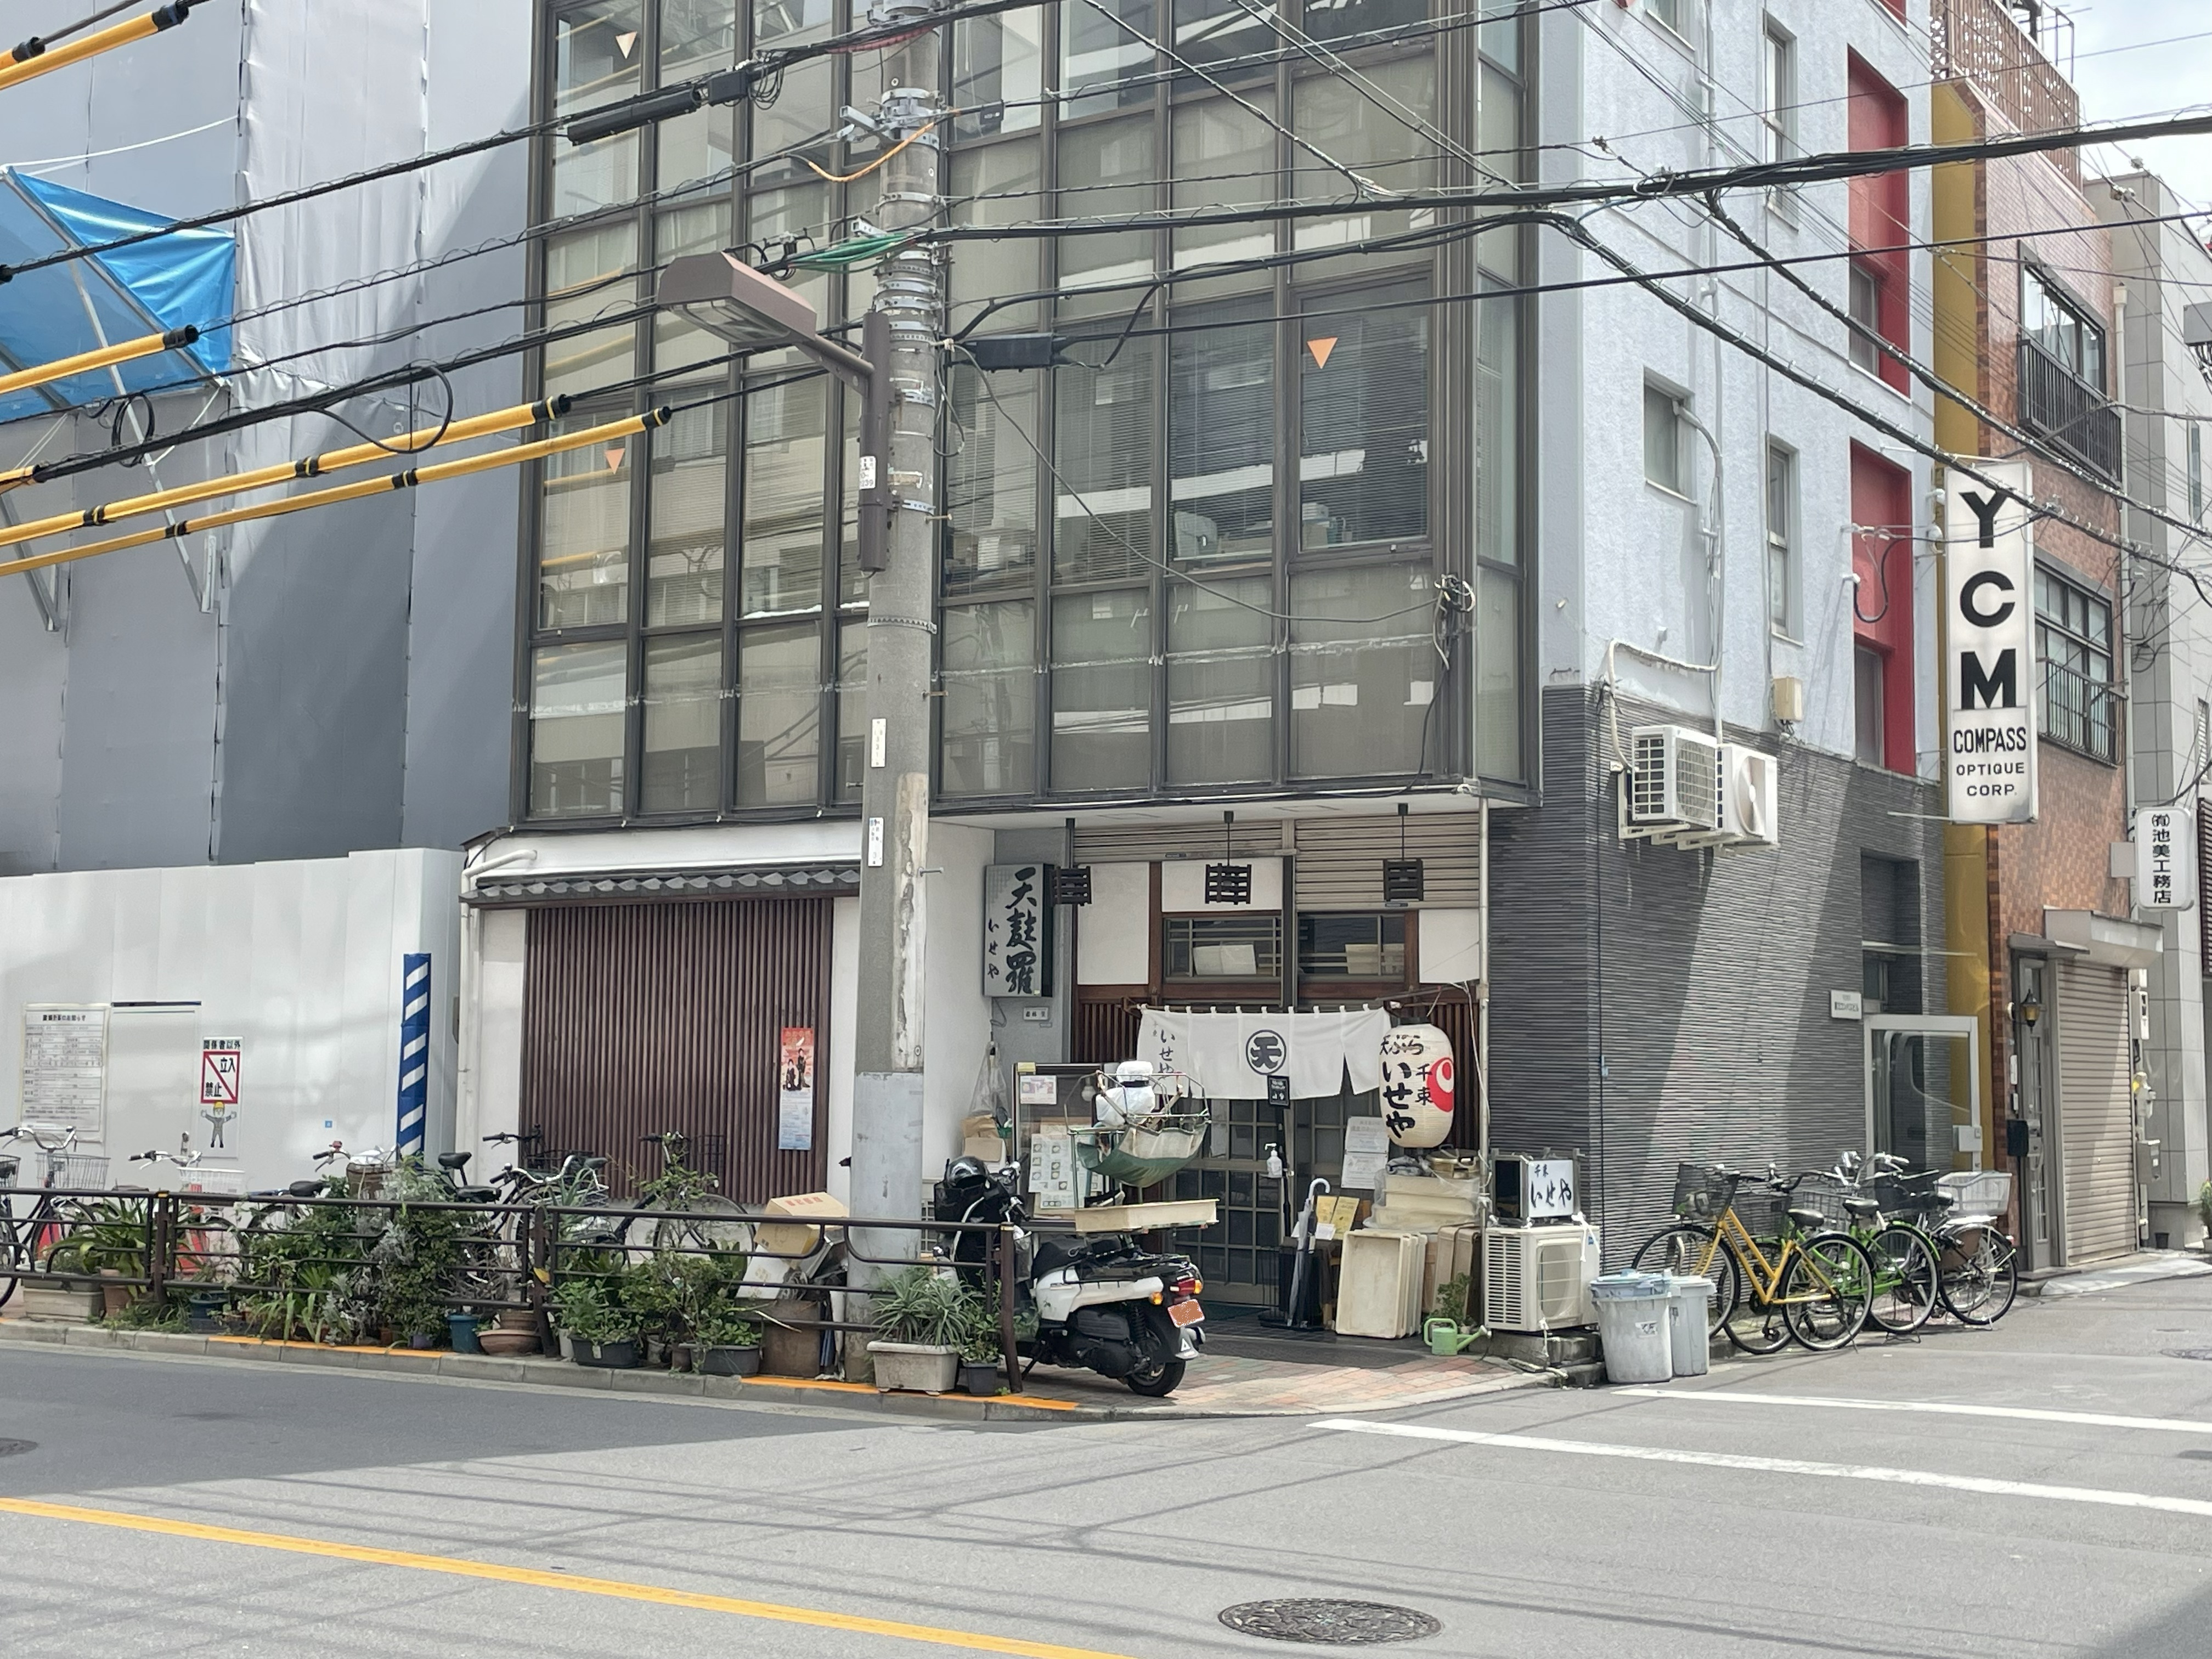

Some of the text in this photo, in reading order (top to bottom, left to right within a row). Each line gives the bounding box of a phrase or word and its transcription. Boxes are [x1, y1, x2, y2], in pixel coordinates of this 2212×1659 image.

[1959, 491, 2017, 710] YCM
[1954, 726, 2026, 753] COMPASS
[1956, 762, 2024, 775] OPTIQUE
[1967, 784, 2017, 796] CORP.
[987, 918, 1000, 979] いせや
[203, 1040, 240, 1049] 関係者以外
[1250, 1035, 1282, 1070] 天
[1379, 1034, 1425, 1056] 天ぷら
[220, 1057, 236, 1073] 立入
[205, 1081, 222, 1097] 禁止
[1382, 1060, 1415, 1139] いせや
[1530, 1177, 1572, 1208] いせや
